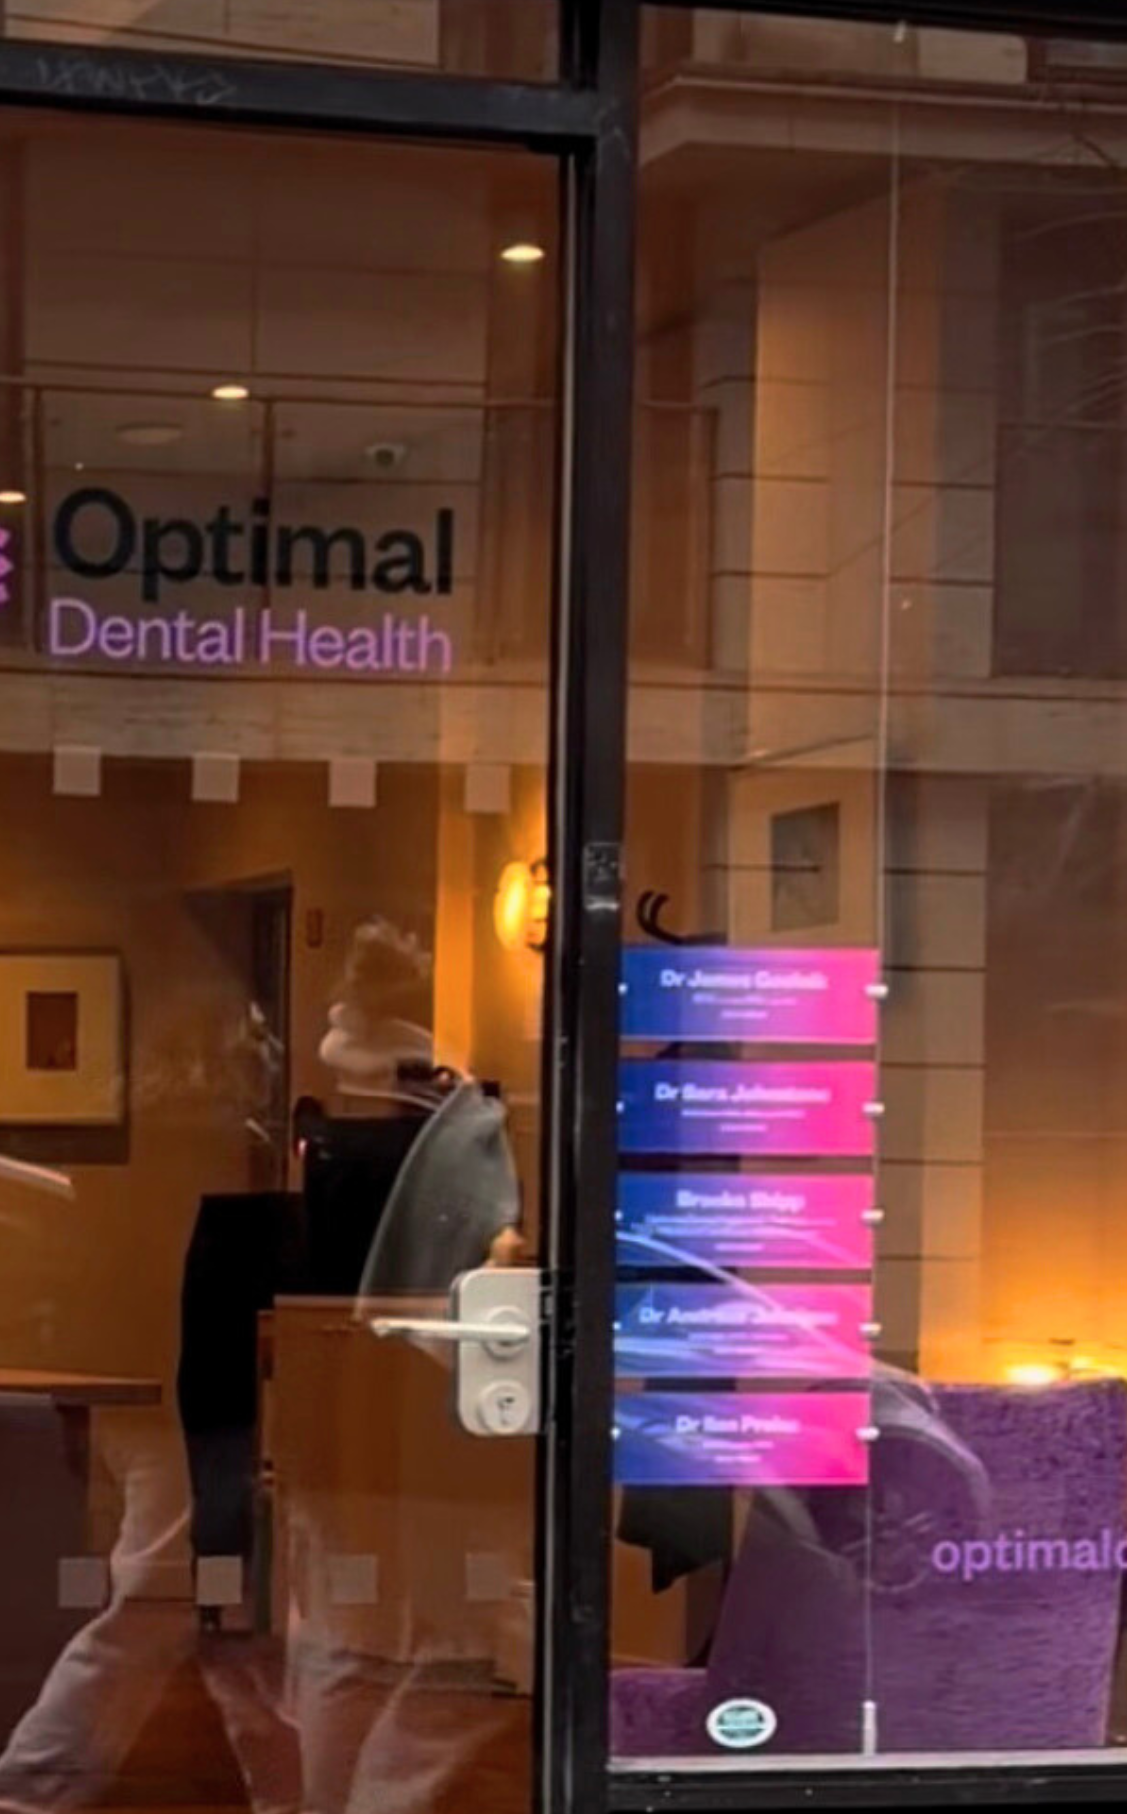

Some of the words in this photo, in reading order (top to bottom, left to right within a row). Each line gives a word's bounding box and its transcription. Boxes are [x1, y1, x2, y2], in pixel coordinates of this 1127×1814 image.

[53, 487, 454, 601] Optimal
[49, 597, 245, 663] Dental
[260, 608, 452, 673] Health
[660, 969, 685, 988] Dr
[654, 1082, 679, 1101] Dr
